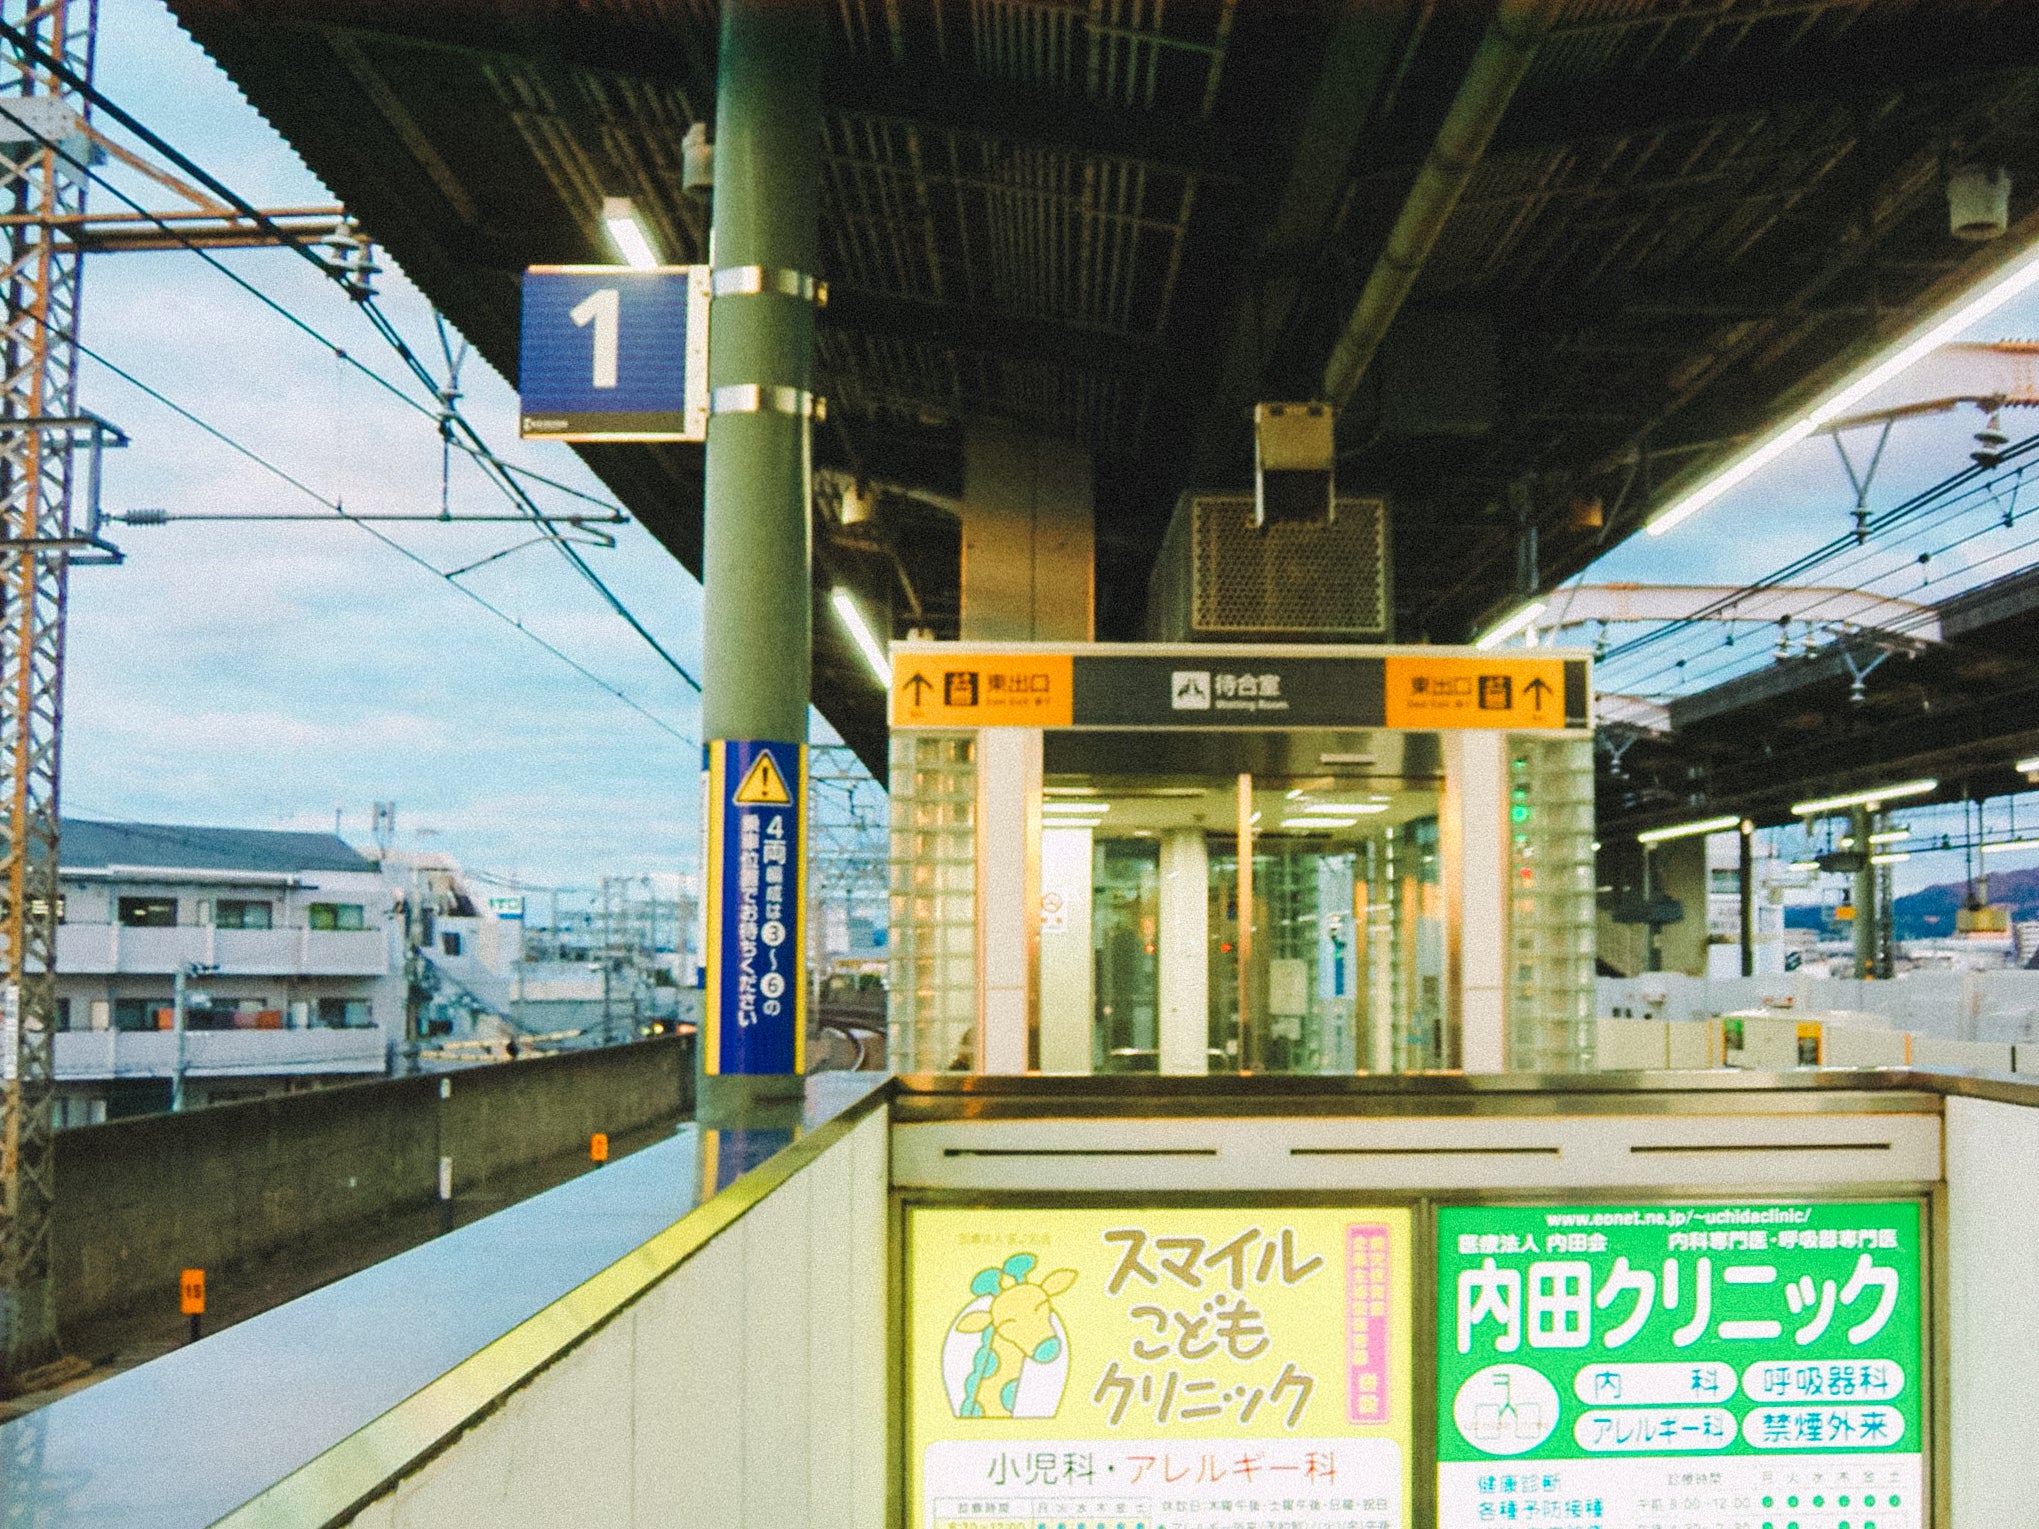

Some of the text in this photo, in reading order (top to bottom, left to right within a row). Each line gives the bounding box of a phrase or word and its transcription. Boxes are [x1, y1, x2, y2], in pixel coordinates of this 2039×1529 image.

[569, 289, 619, 388] 1
[987, 674, 1050, 693] 東出口
[1215, 673, 1281, 696] 待合室
[1411, 676, 1472, 695] 東出口
[1458, 1232, 1608, 1254] 医療法人 内田会
[1104, 1227, 1324, 1294] スマイル
[1457, 1253, 1900, 1354] 内田クリニック
[1130, 1295, 1271, 1361] こども
[1093, 1362, 1316, 1429] クリニック
[1764, 1366, 1889, 1397] 呼吸器科
[1593, 1414, 1724, 1445] アレルギー科
[1763, 1411, 1889, 1443] 禁煙外来
[1478, 1473, 1561, 1494] 健康診断
[1478, 1498, 1603, 1521] 各種予防接種
